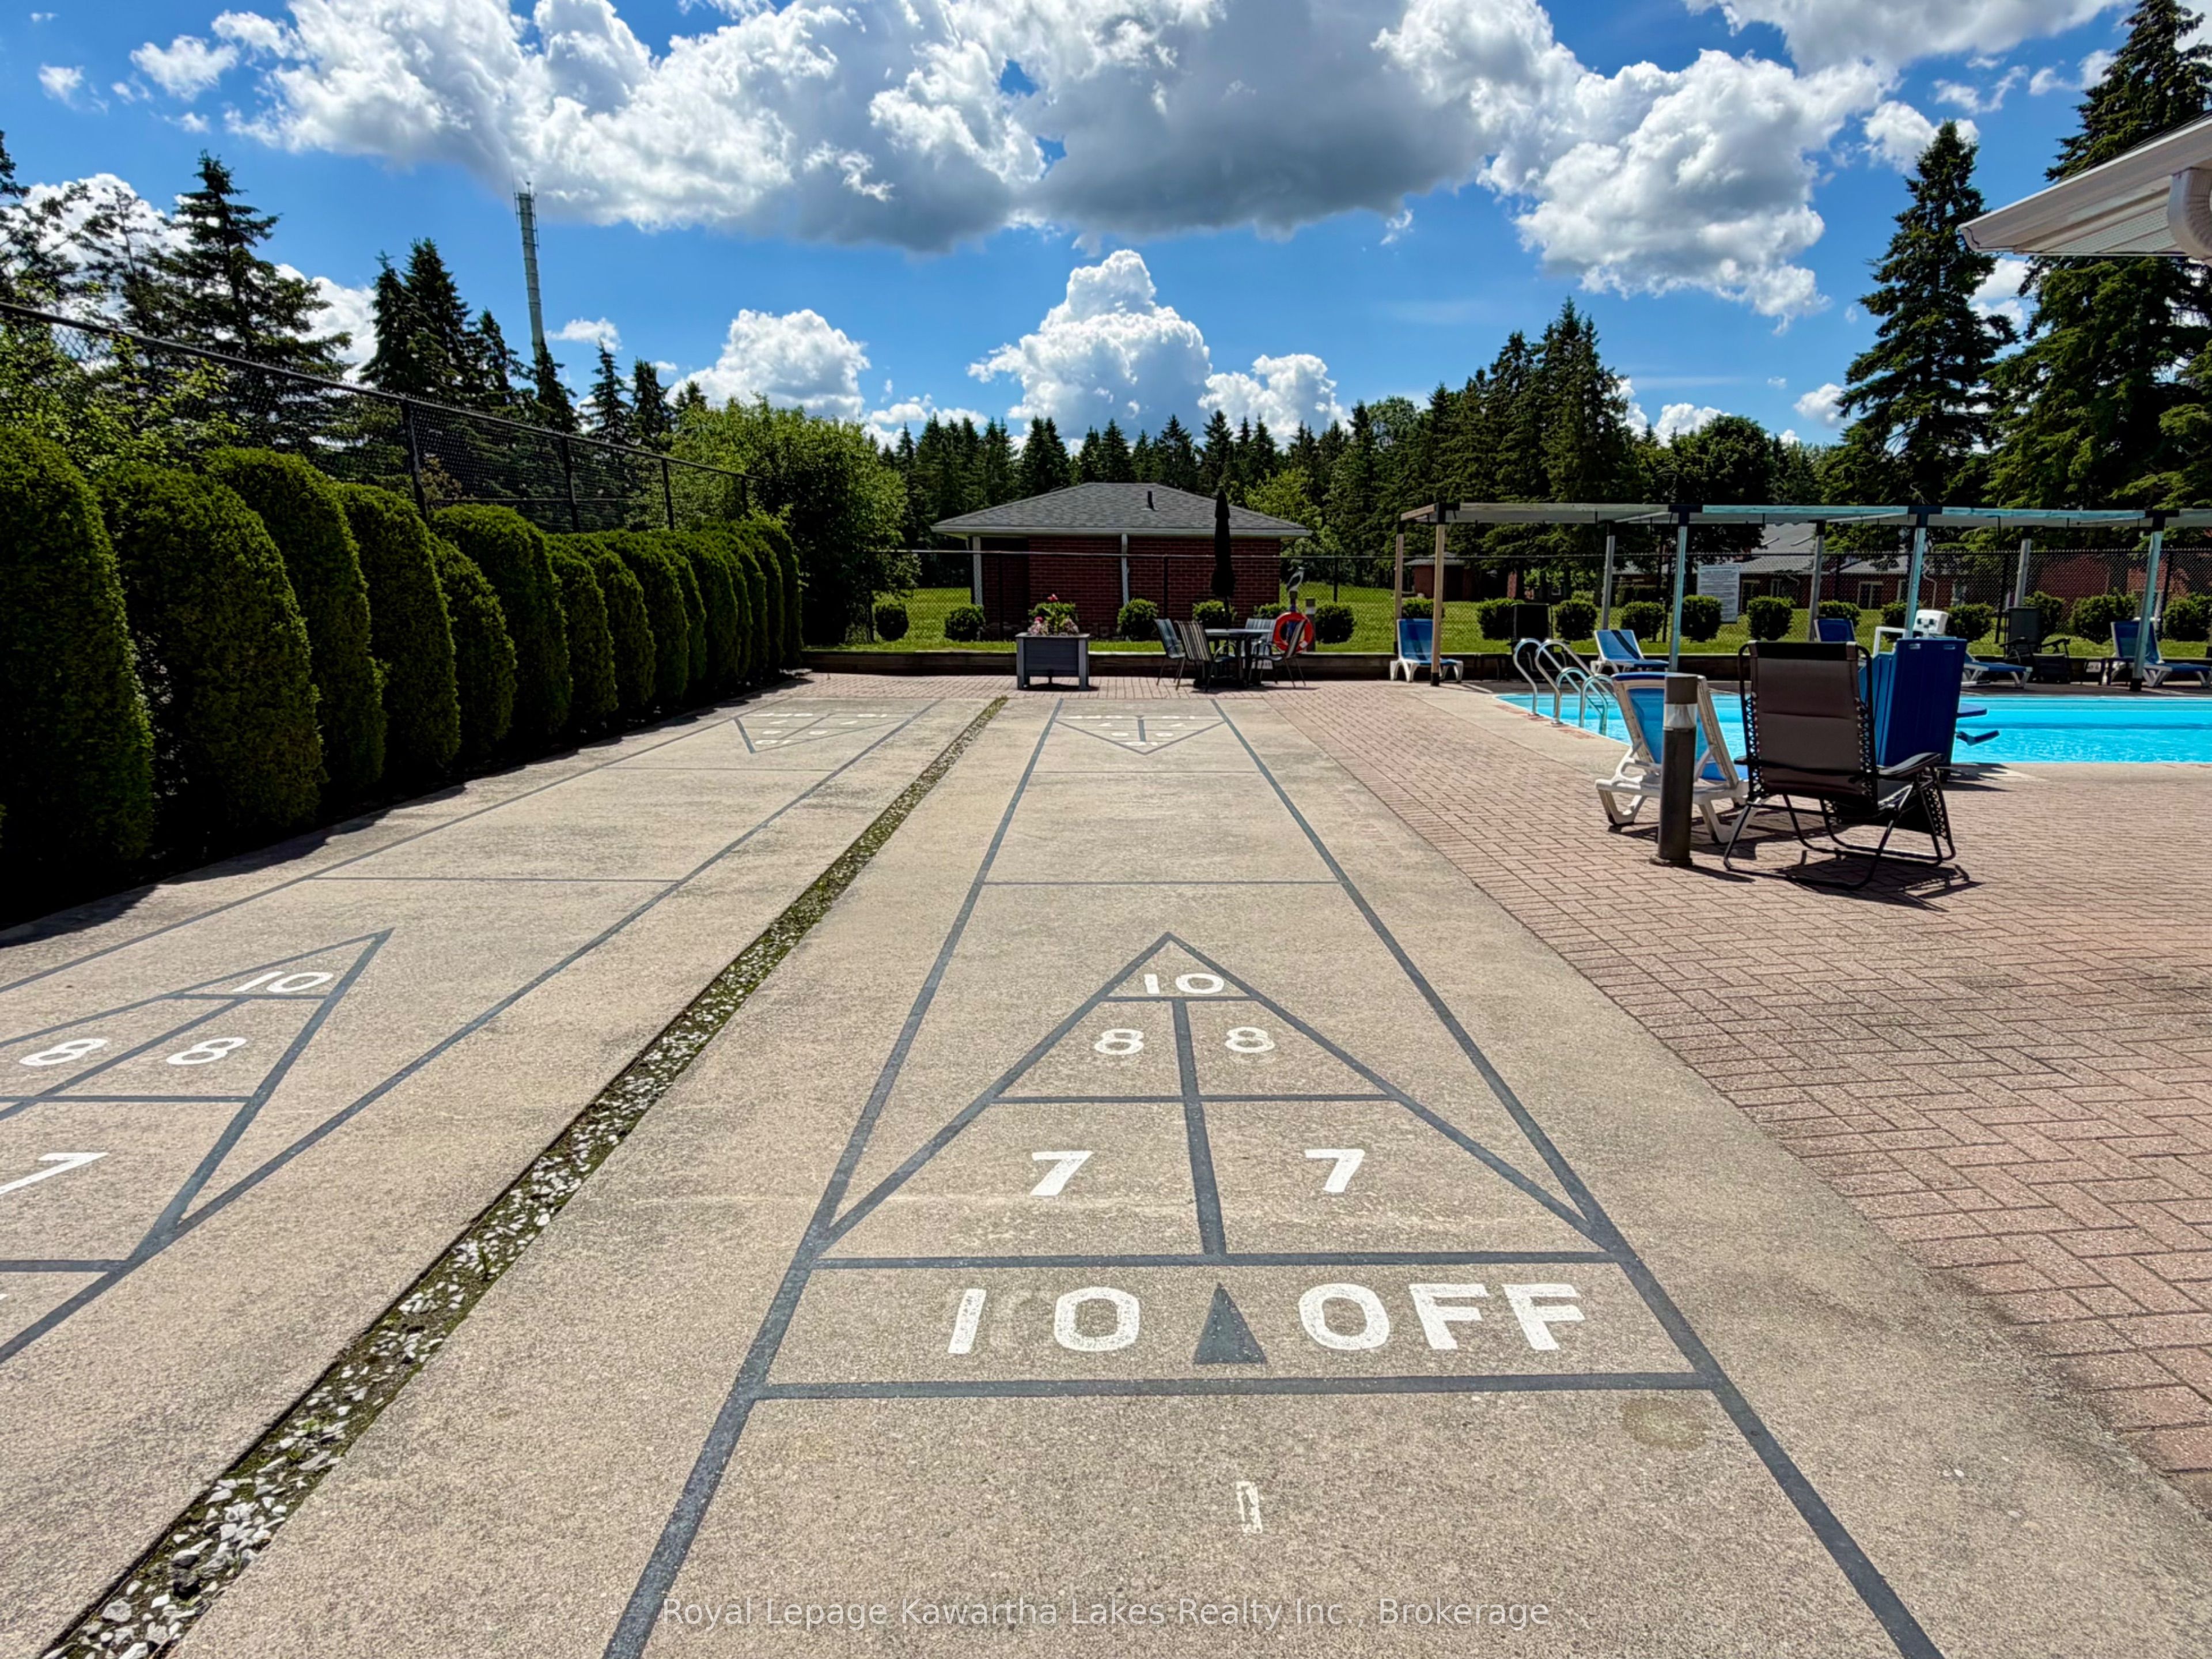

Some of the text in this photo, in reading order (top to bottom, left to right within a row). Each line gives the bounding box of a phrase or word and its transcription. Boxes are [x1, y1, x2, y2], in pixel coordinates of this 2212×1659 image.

[232, 971, 334, 993] 10
[1144, 972, 1225, 995] 10
[19, 1038, 108, 1066] 8
[166, 1037, 247, 1065] 8
[1093, 1028, 1145, 1055] 8
[1225, 1027, 1275, 1054] 8
[1030, 1150, 1093, 1196] 7
[1305, 1149, 1366, 1193] 7
[948, 1283, 1585, 1354] 10 OFF
